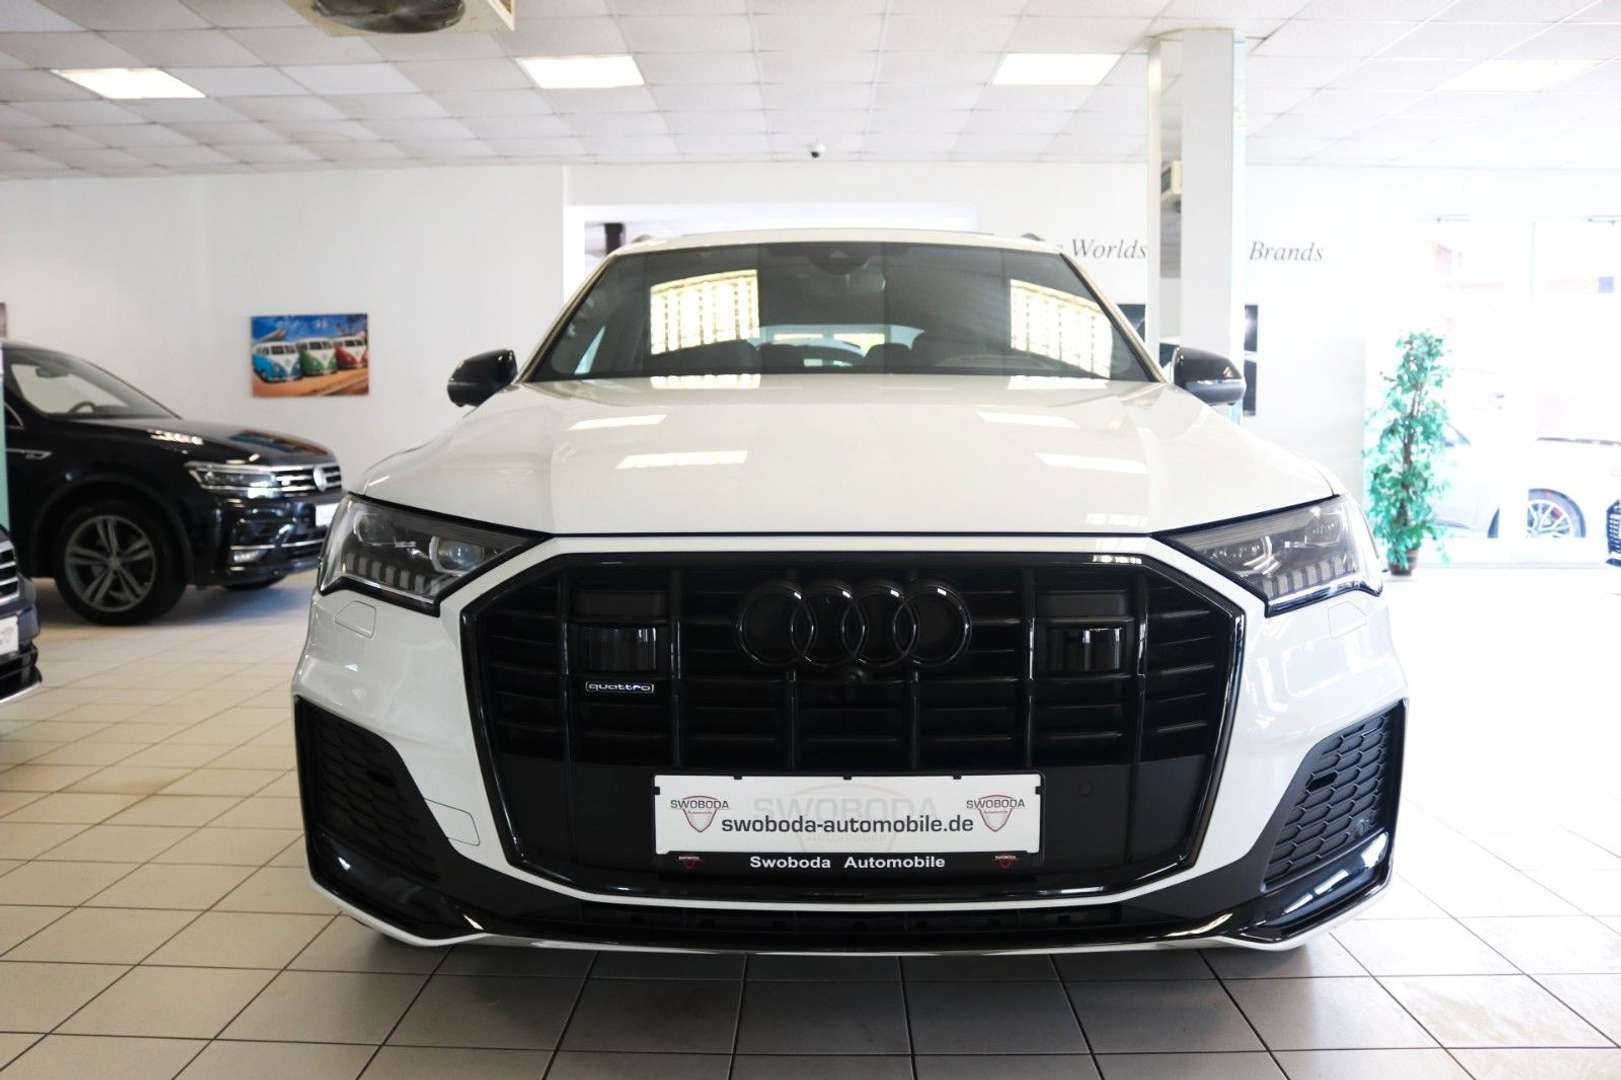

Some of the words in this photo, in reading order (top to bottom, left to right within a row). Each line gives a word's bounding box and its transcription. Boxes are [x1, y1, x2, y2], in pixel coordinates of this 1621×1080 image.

[1071, 238, 1147, 260] Worlds
[1249, 240, 1325, 262] Brands
[588, 683, 651, 692] quattro
[670, 799, 729, 809] SWOBODA
[966, 799, 1025, 809] SWOBODA
[721, 813, 974, 833] swoboda-automobile.de
[749, 855, 831, 869] Swoboda
[844, 855, 946, 869] Automobile
